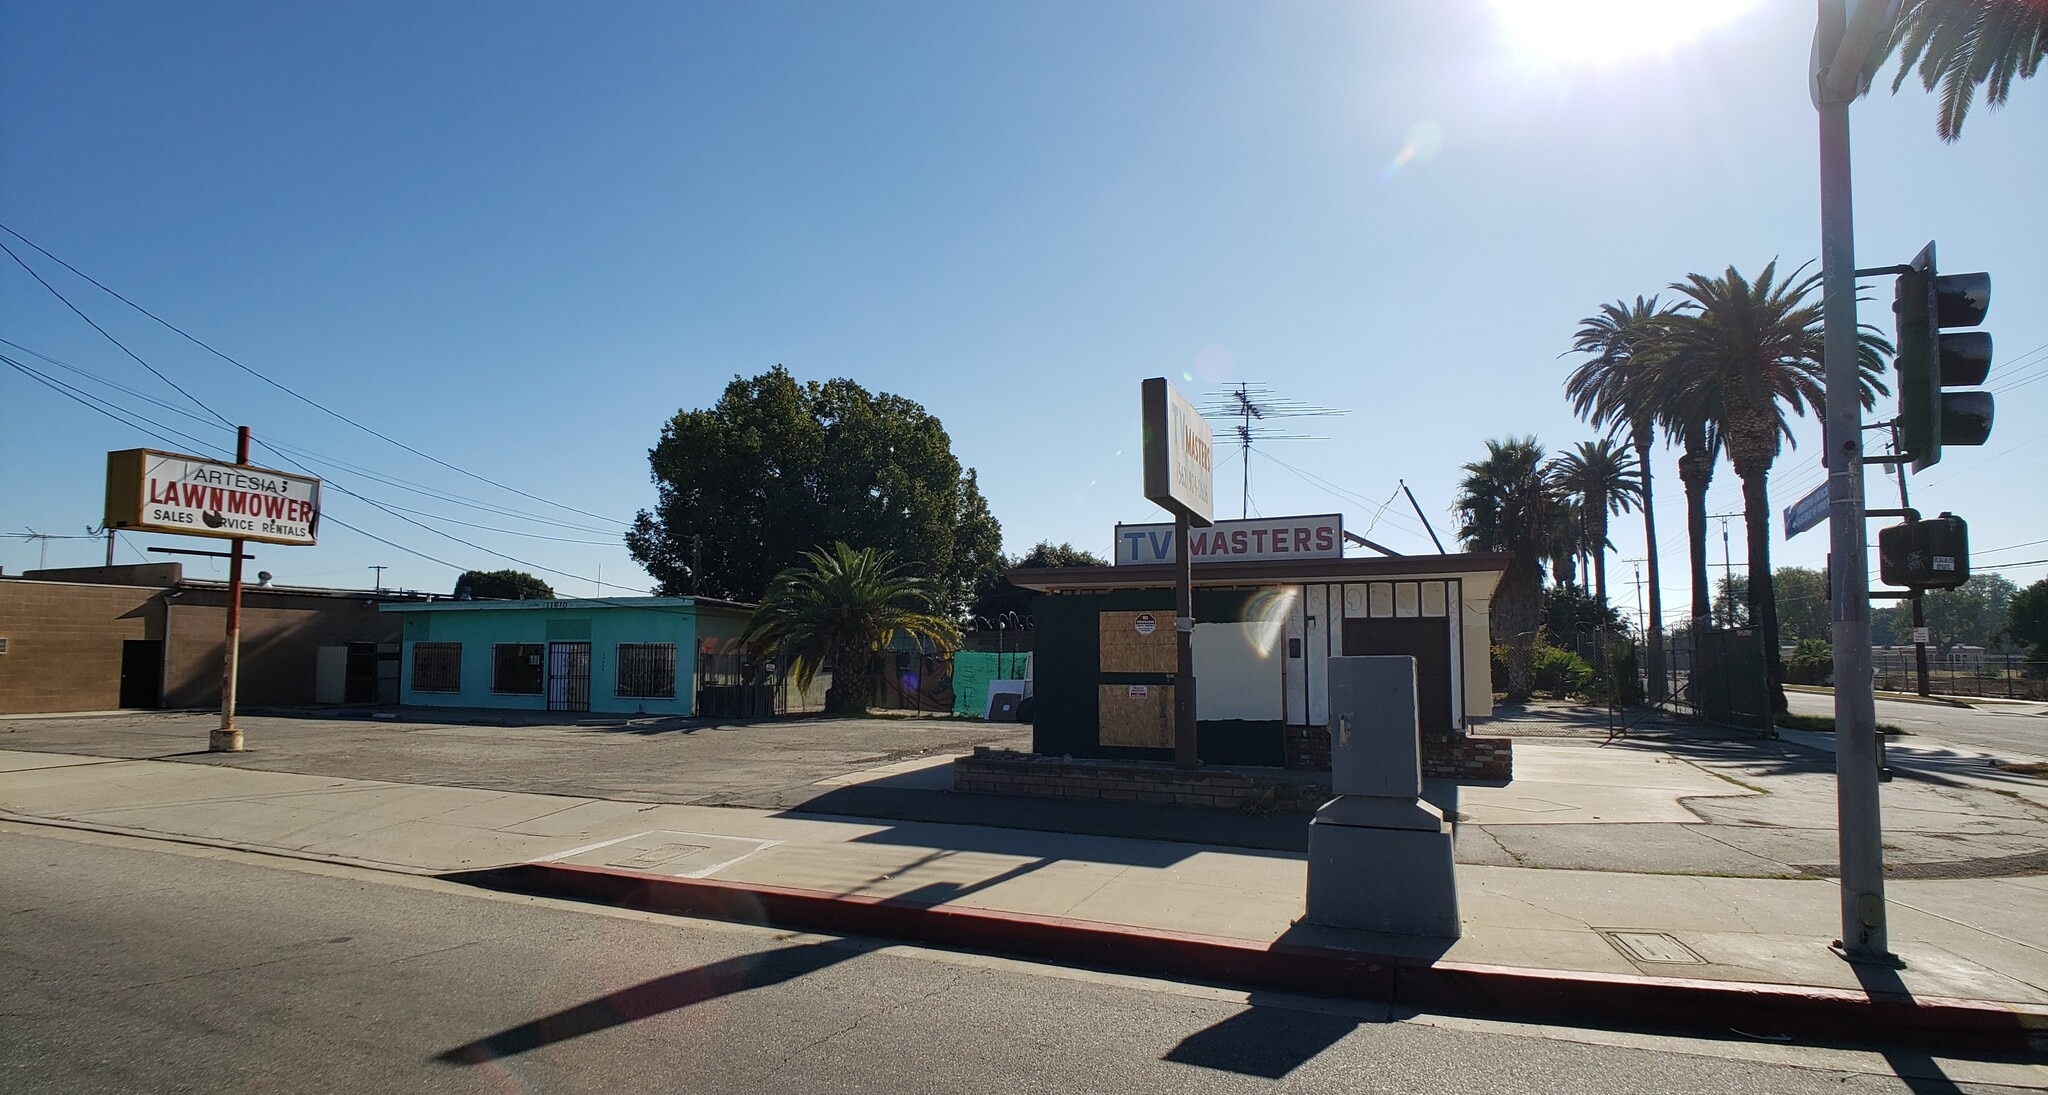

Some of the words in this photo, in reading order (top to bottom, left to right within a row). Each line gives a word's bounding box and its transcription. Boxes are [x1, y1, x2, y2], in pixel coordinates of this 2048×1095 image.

[1172, 404, 1186, 450] TV
[1185, 424, 1211, 473] MASTERS
[193, 468, 278, 493] ARTESIA
[150, 478, 313, 523] LAWNMOWER
[154, 509, 194, 524] SALES
[262, 522, 306, 537] RENTALS
[1123, 531, 1173, 561] TV
[1189, 526, 1334, 556] MASTERS
